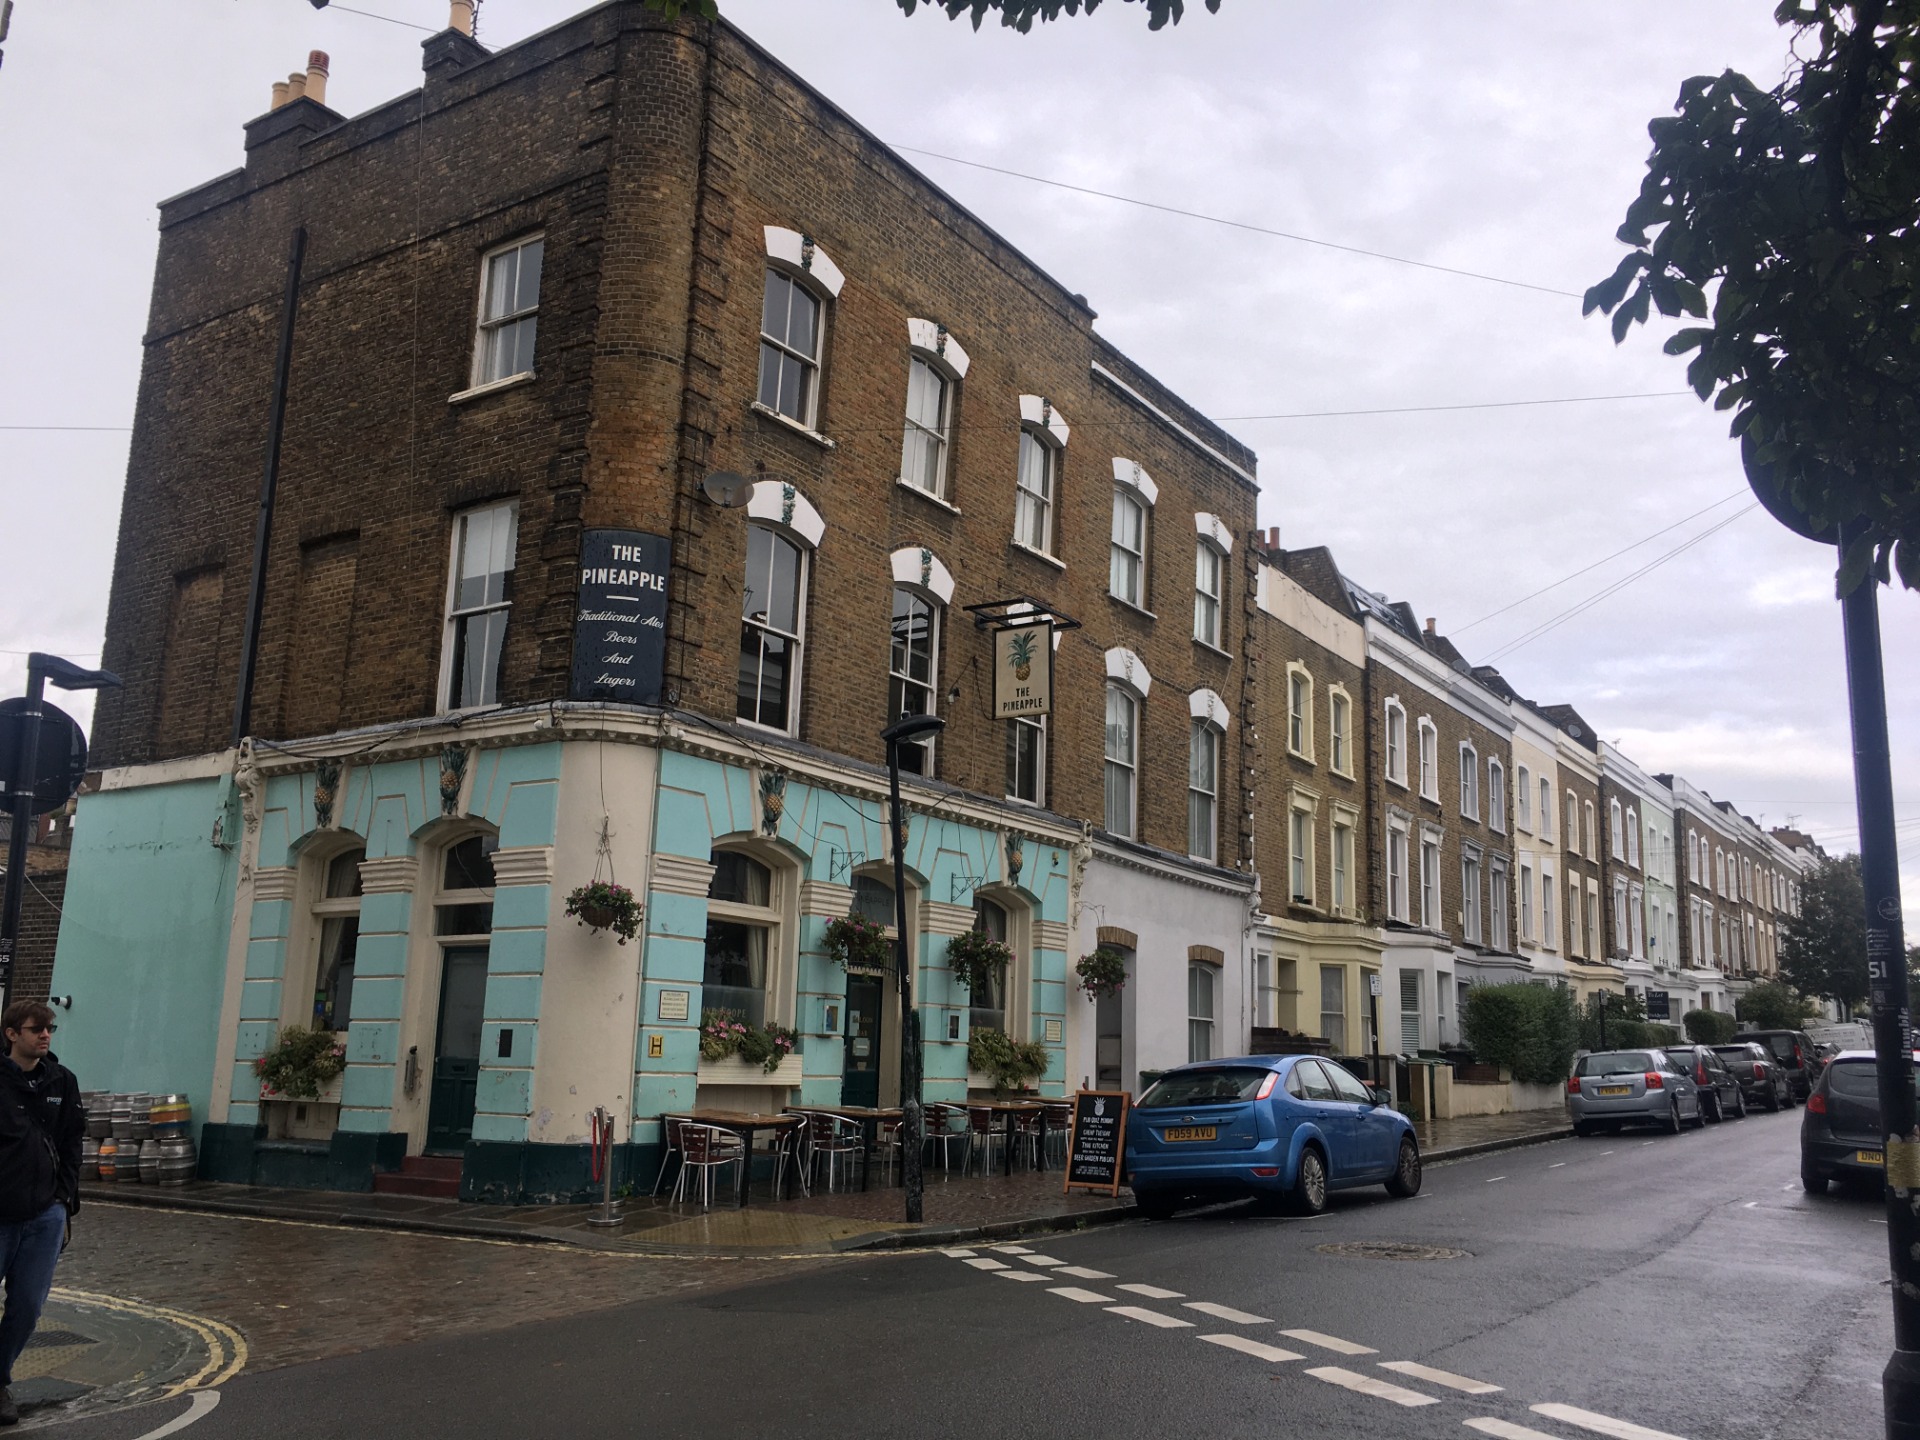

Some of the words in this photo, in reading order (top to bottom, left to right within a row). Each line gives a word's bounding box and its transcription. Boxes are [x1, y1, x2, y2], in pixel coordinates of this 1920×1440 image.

[612, 545, 641, 562] THE
[582, 568, 665, 592] PINEAPPLE
[577, 609, 639, 624] Traditional
[640, 616, 665, 629] Ales
[603, 631, 638, 645] Beers
[602, 652, 634, 665] And
[594, 672, 637, 687] Lagers
[1016, 687, 1030, 697] THE
[1003, 697, 1043, 712] PINEAPPLE
[651, 1036, 662, 1055] H
[1168, 1128, 1191, 1139] FD59
[1194, 1127, 1213, 1138] AVU
[1092, 1142, 1109, 1150] KITCHEN
[1073, 1153, 1084, 1161] BEER
